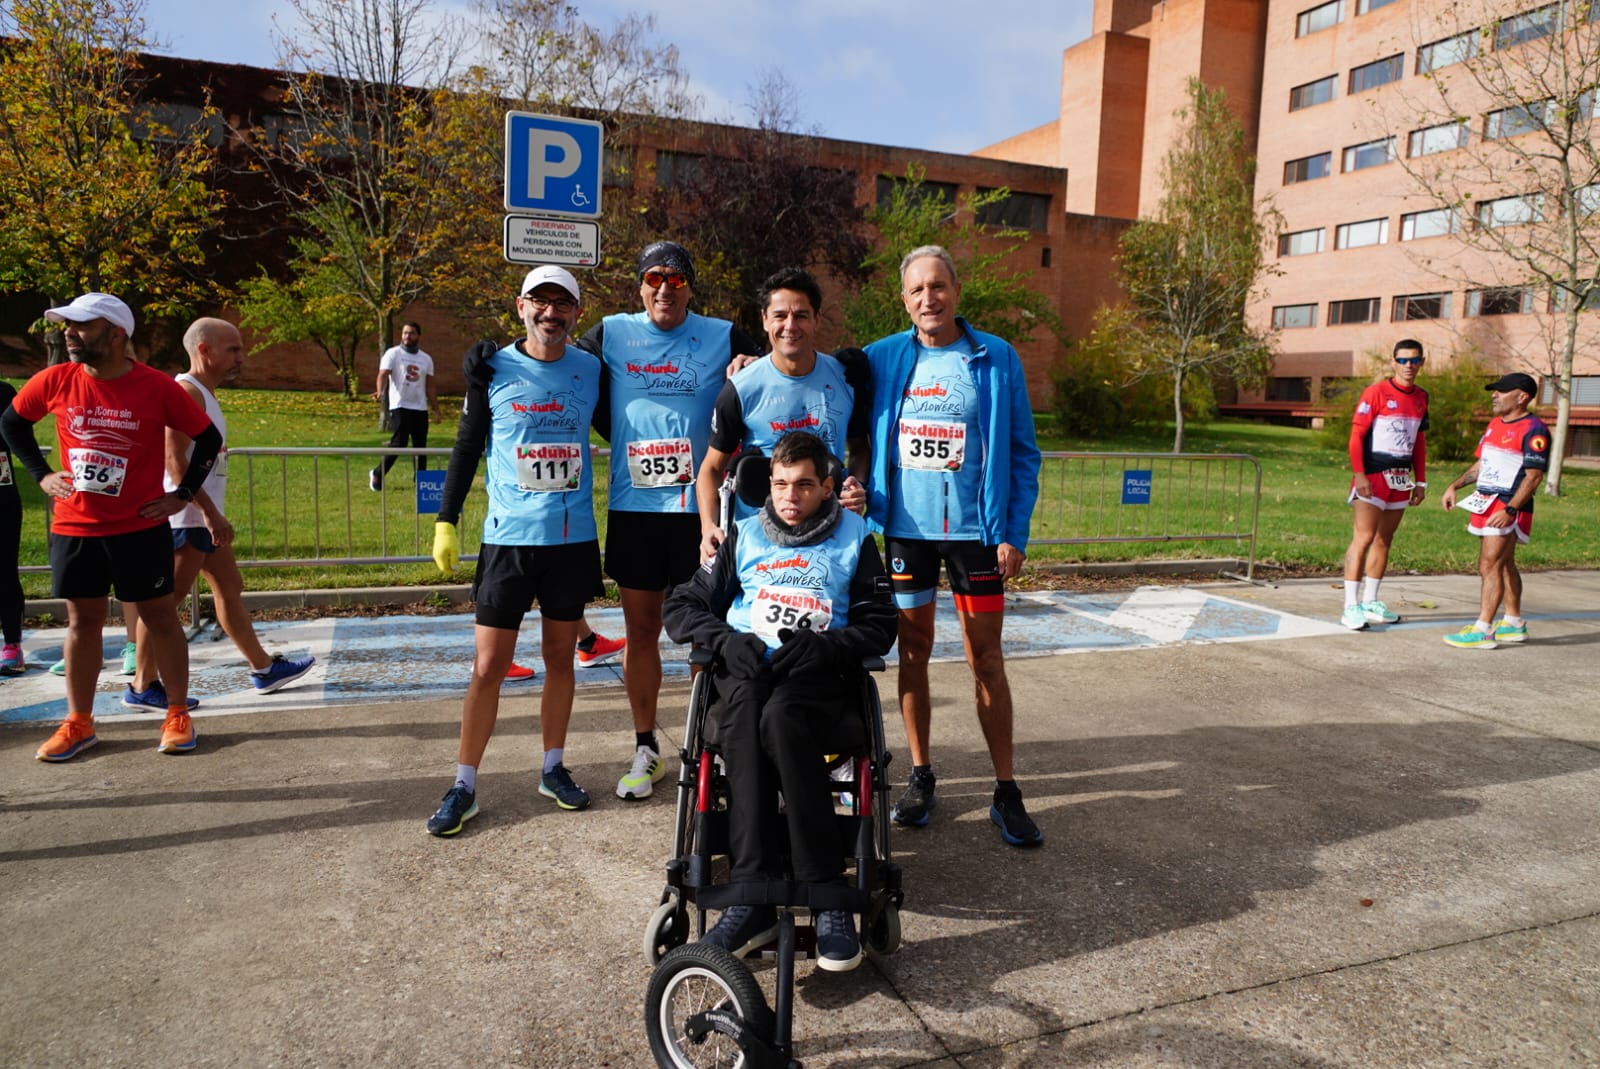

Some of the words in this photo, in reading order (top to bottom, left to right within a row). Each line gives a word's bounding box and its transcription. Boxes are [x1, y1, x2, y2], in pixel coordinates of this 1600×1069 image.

[528, 127, 582, 200] P
[530, 220, 576, 231] RESERVADO
[569, 231, 581, 239] DE
[523, 237, 564, 248] PERSONAS
[565, 241, 583, 249] CON
[512, 246, 553, 256] MOVILIDAD
[554, 250, 593, 259] REDUCIDA
[119, 408, 132, 419] sin
[900, 423, 964, 439] bedunia
[628, 441, 690, 457] bedunia
[909, 439, 950, 459] 355
[532, 460, 569, 480] 111
[640, 456, 679, 476] 353
[420, 481, 446, 491] POLI
[421, 492, 443, 501] LOC
[765, 604, 813, 630] 356
